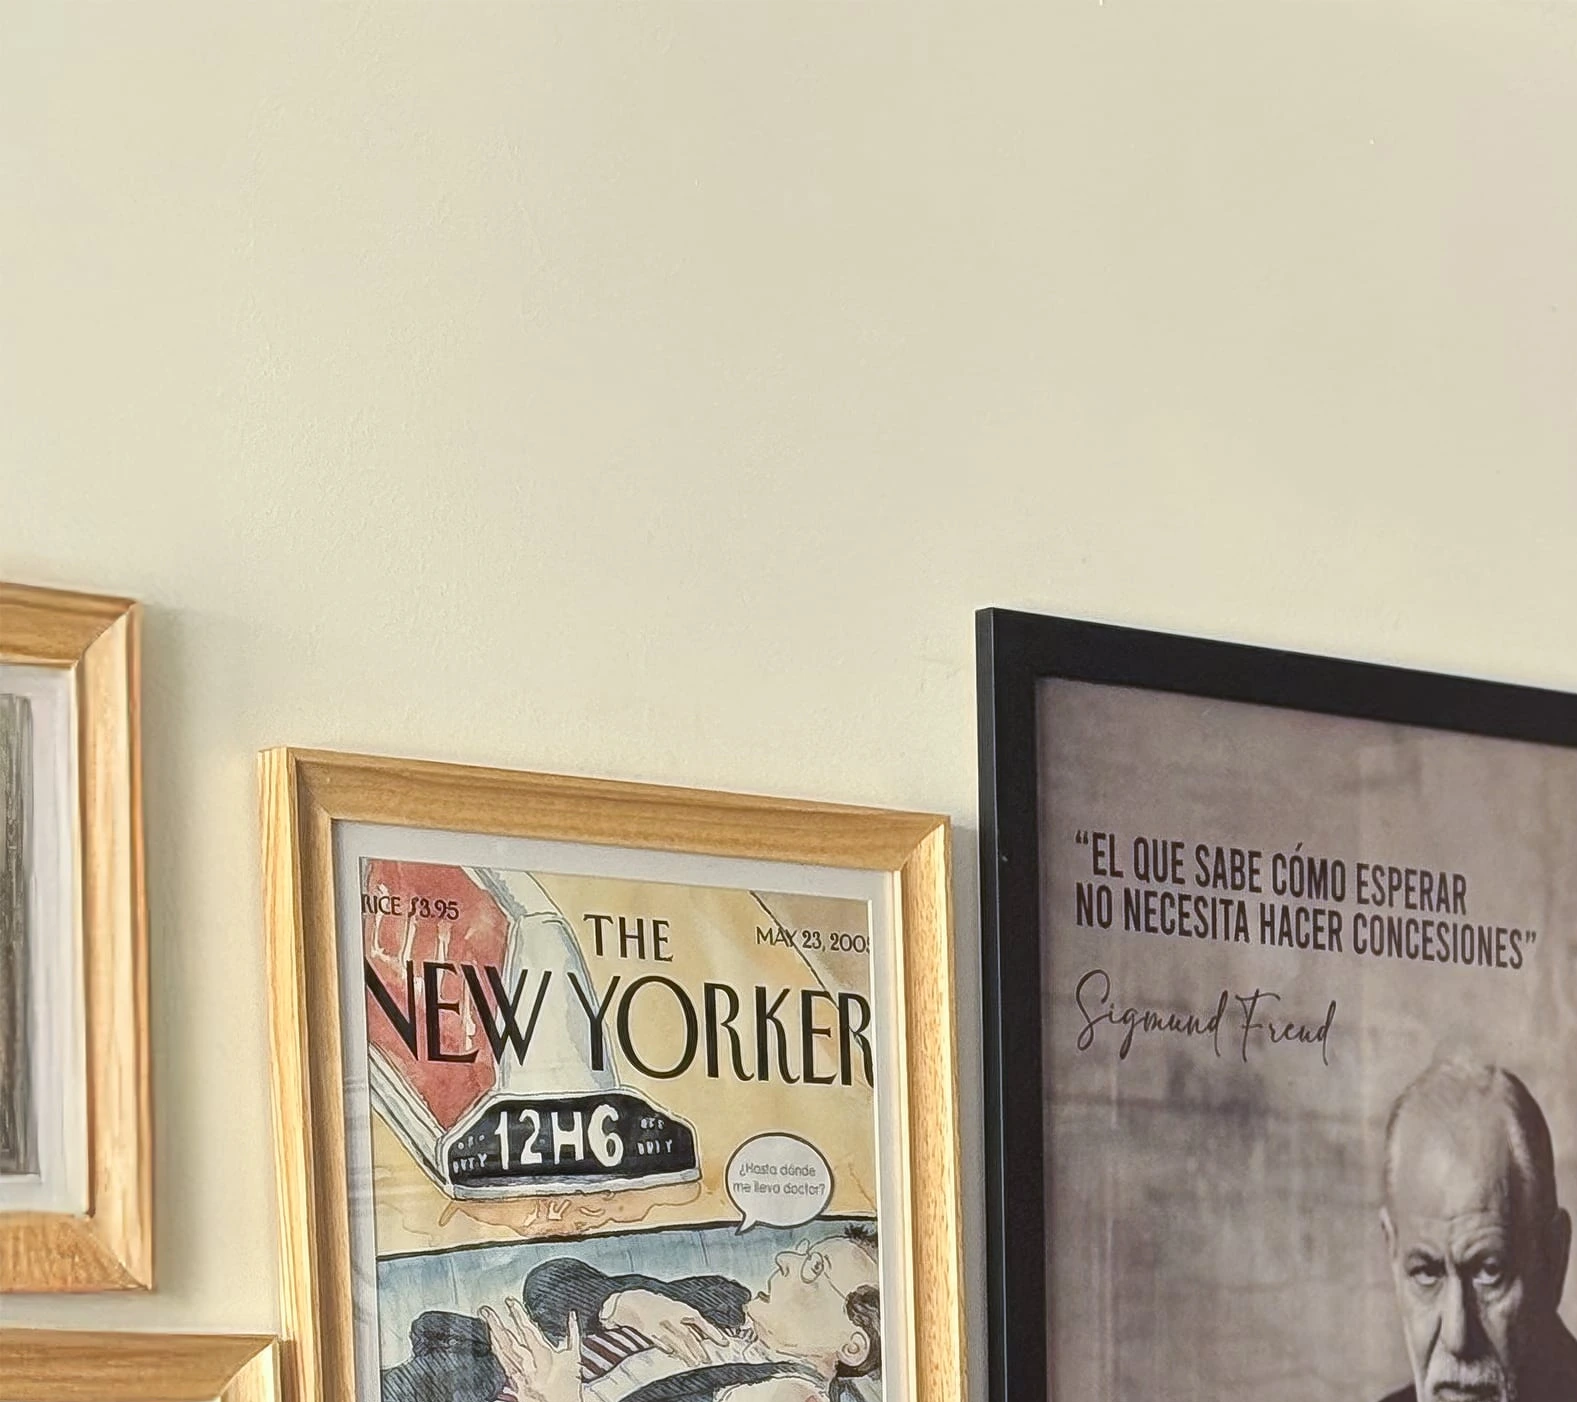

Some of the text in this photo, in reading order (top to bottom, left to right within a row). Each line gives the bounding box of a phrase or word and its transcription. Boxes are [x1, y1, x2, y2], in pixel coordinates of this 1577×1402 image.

[1133, 836, 1186, 887] QUE
[1194, 843, 1262, 894] SABE
[1272, 842, 1346, 903] CÓMO
[1356, 862, 1468, 916] ESPERAR
[408, 896, 460, 920] $3.95
[1075, 882, 1113, 930] NO
[1123, 887, 1250, 944] NECESITA
[1259, 901, 1344, 953] HACER
[583, 914, 674, 962] THE
[756, 926, 798, 948] MAY
[801, 929, 826, 952] 23,
[364, 955, 874, 1089] NEW YORKER
[1075, 968, 1338, 1067] Sigmund Freud
[494, 1103, 625, 1169] 12H6
[733, 1181, 752, 1194] me
[783, 1182, 825, 1197] doctor?
[739, 1162, 817, 1177] ¿Hasta dónde
